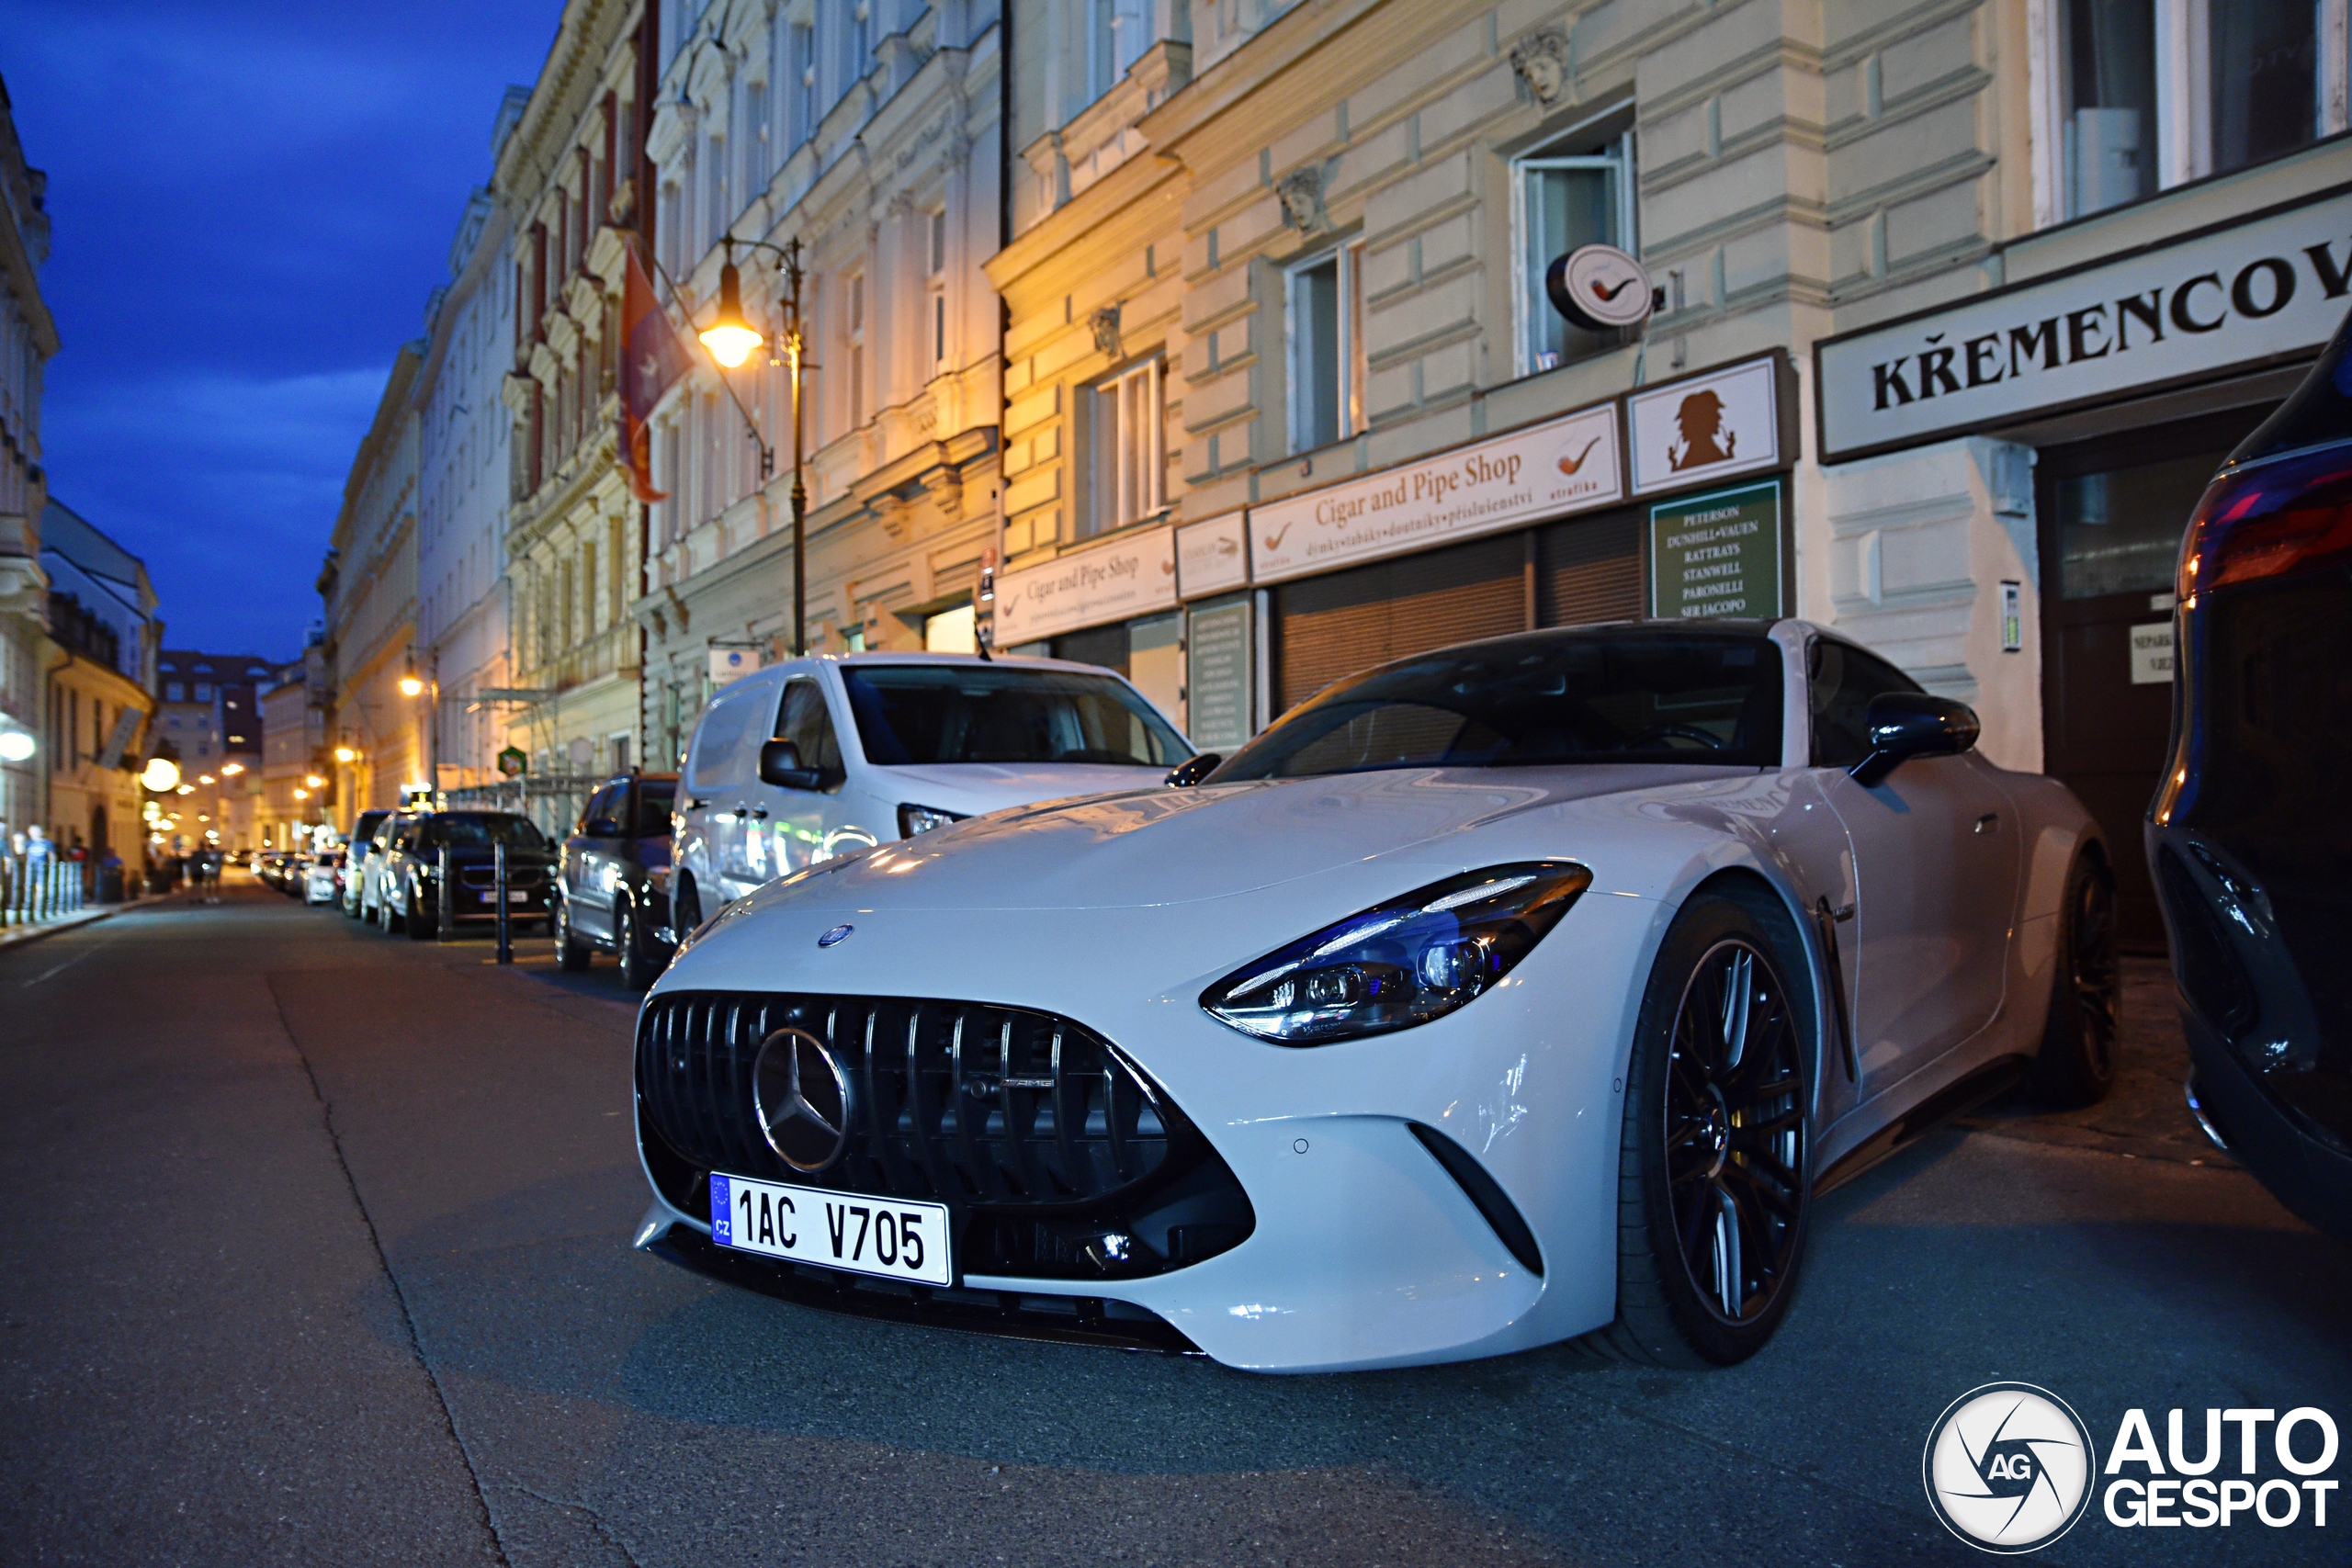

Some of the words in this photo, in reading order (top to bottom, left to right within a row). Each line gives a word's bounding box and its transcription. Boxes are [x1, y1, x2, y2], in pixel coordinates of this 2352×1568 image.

[1316, 496, 1365, 528] Cigar
[1370, 477, 1408, 511] and
[1413, 469, 1459, 504] Pipe
[1465, 453, 1521, 488] Shop
[1683, 504, 1740, 527] PETERSON
[1684, 542, 1740, 563] RATTRAYS
[1026, 578, 1055, 603] Cigar
[1057, 567, 1078, 591] and
[1080, 562, 1105, 590] Pipe
[1108, 555, 1139, 580] Shop
[1682, 561, 1742, 582] STANWELL
[1682, 580, 1743, 601] PARONELLI
[716, 1219, 730, 1236] CZ
[740, 1190, 797, 1248] 1AC
[826, 1202, 924, 1269] V705
